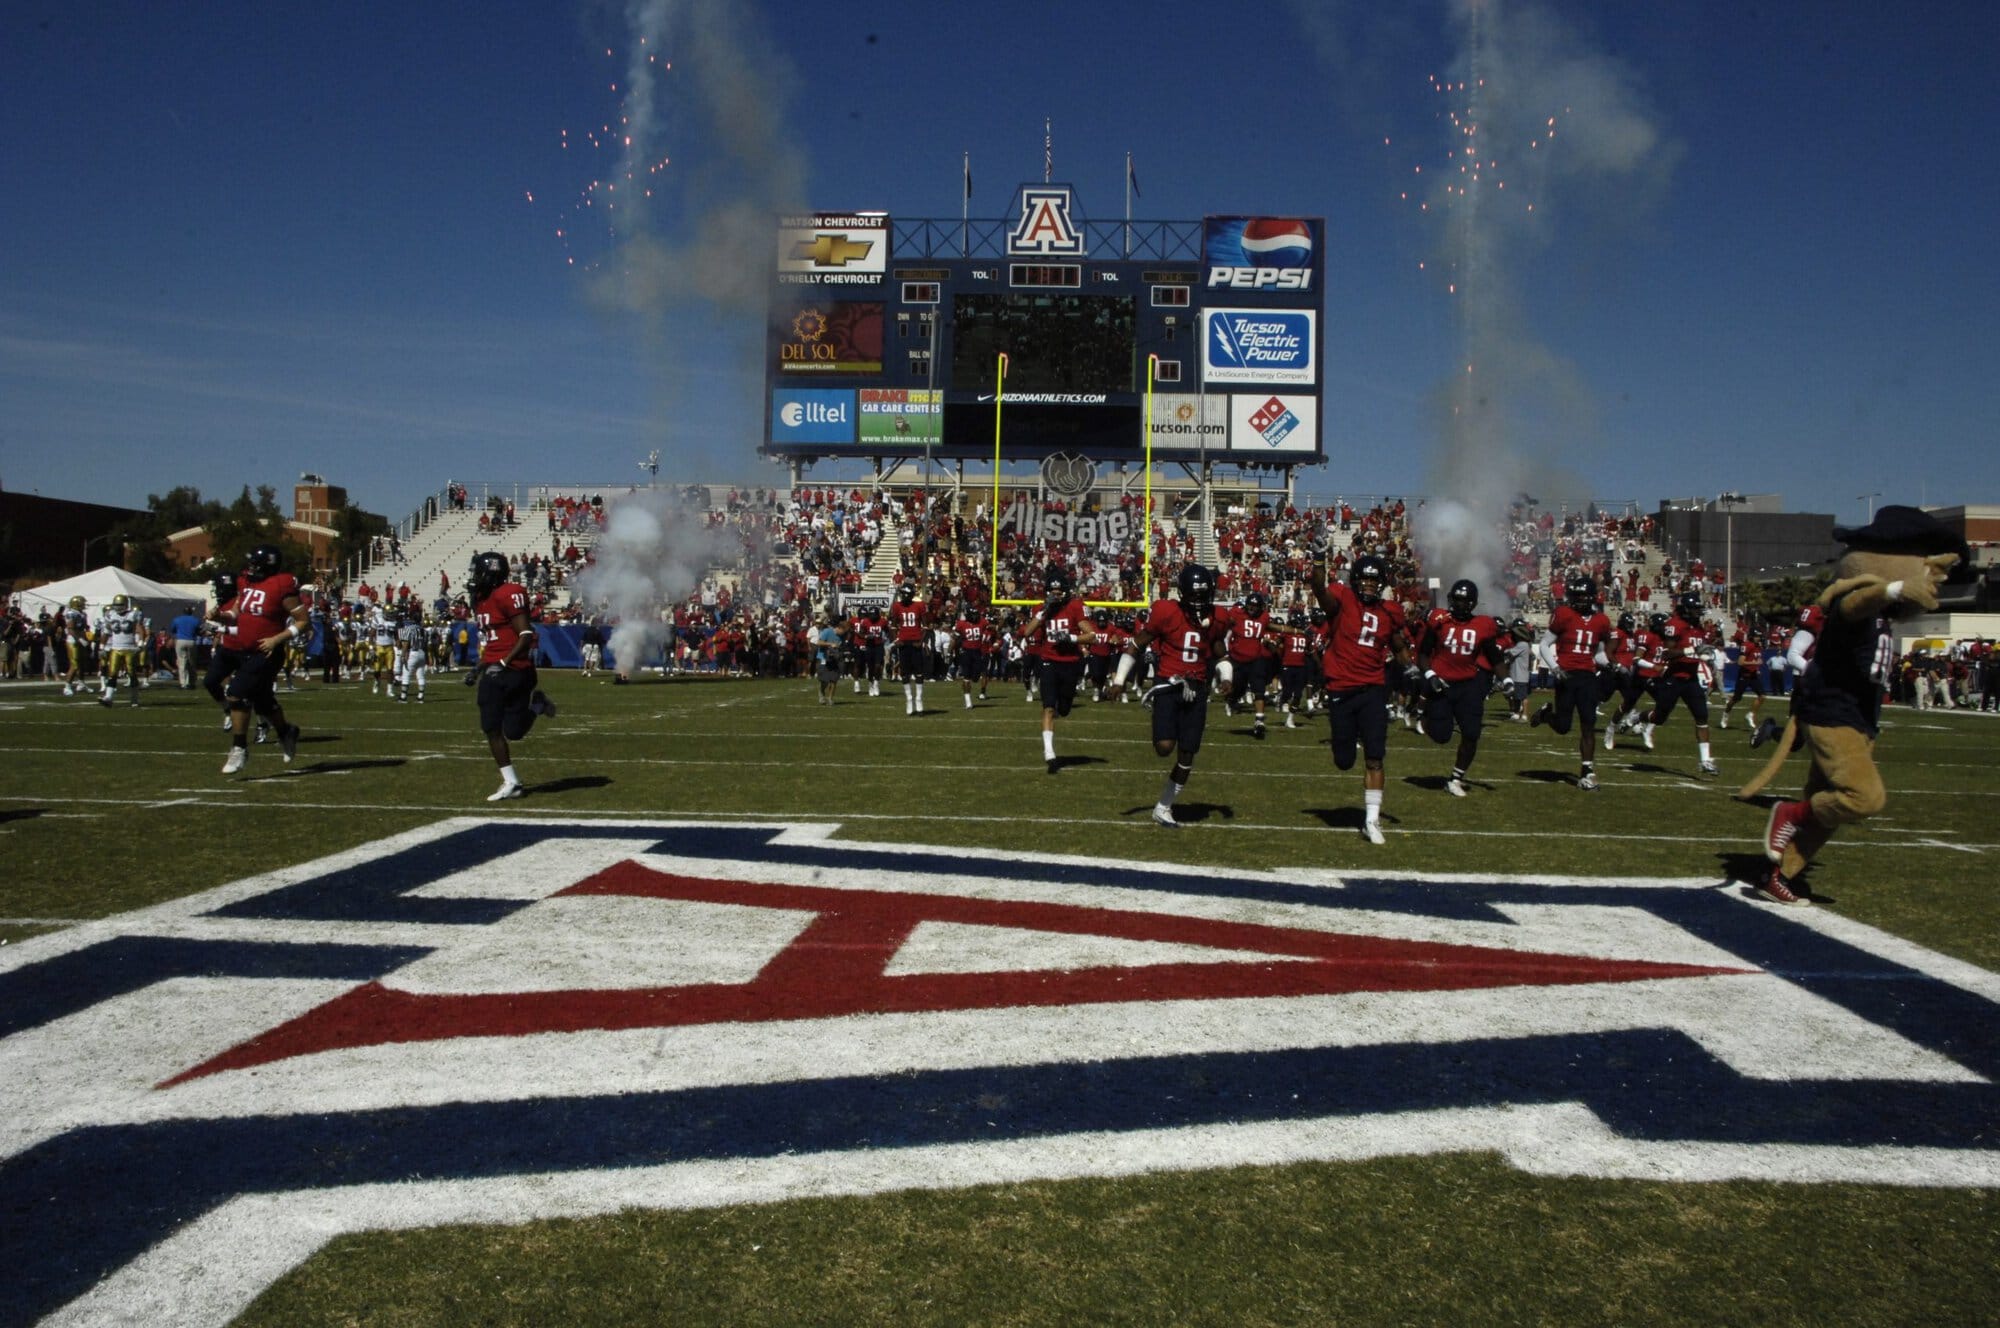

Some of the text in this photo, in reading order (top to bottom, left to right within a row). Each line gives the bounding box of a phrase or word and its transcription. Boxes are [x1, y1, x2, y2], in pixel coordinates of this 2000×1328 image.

[825, 217, 883, 227] CHEVROLET
[1007, 190, 1083, 255] A
[779, 274, 882, 285] O'RIELLY CHEVROLET
[972, 270, 989, 279] TOL
[1102, 272, 1119, 281] TOL
[1207, 267, 1312, 289] PEPSI
[1234, 319, 1286, 334] Tucson
[1239, 333, 1300, 348] Electric
[781, 344, 836, 360] DEL SOL
[1245, 347, 1299, 361] Power
[1250, 372, 1276, 380] Energy
[1276, 373, 1309, 381] Company
[781, 402, 846, 427] alltel
[862, 403, 879, 412] CAR
[881, 403, 903, 413] CARE
[861, 435, 940, 444] www.brakemax.cm
[997, 502, 1129, 546] Allstate
[240, 587, 266, 616] 72
[511, 593, 525, 609] 31
[1244, 619, 1262, 639] 57
[1358, 611, 1379, 647] 2
[1182, 631, 1202, 664] 6
[1443, 627, 1477, 656] 49
[1572, 629, 1594, 654] 11
